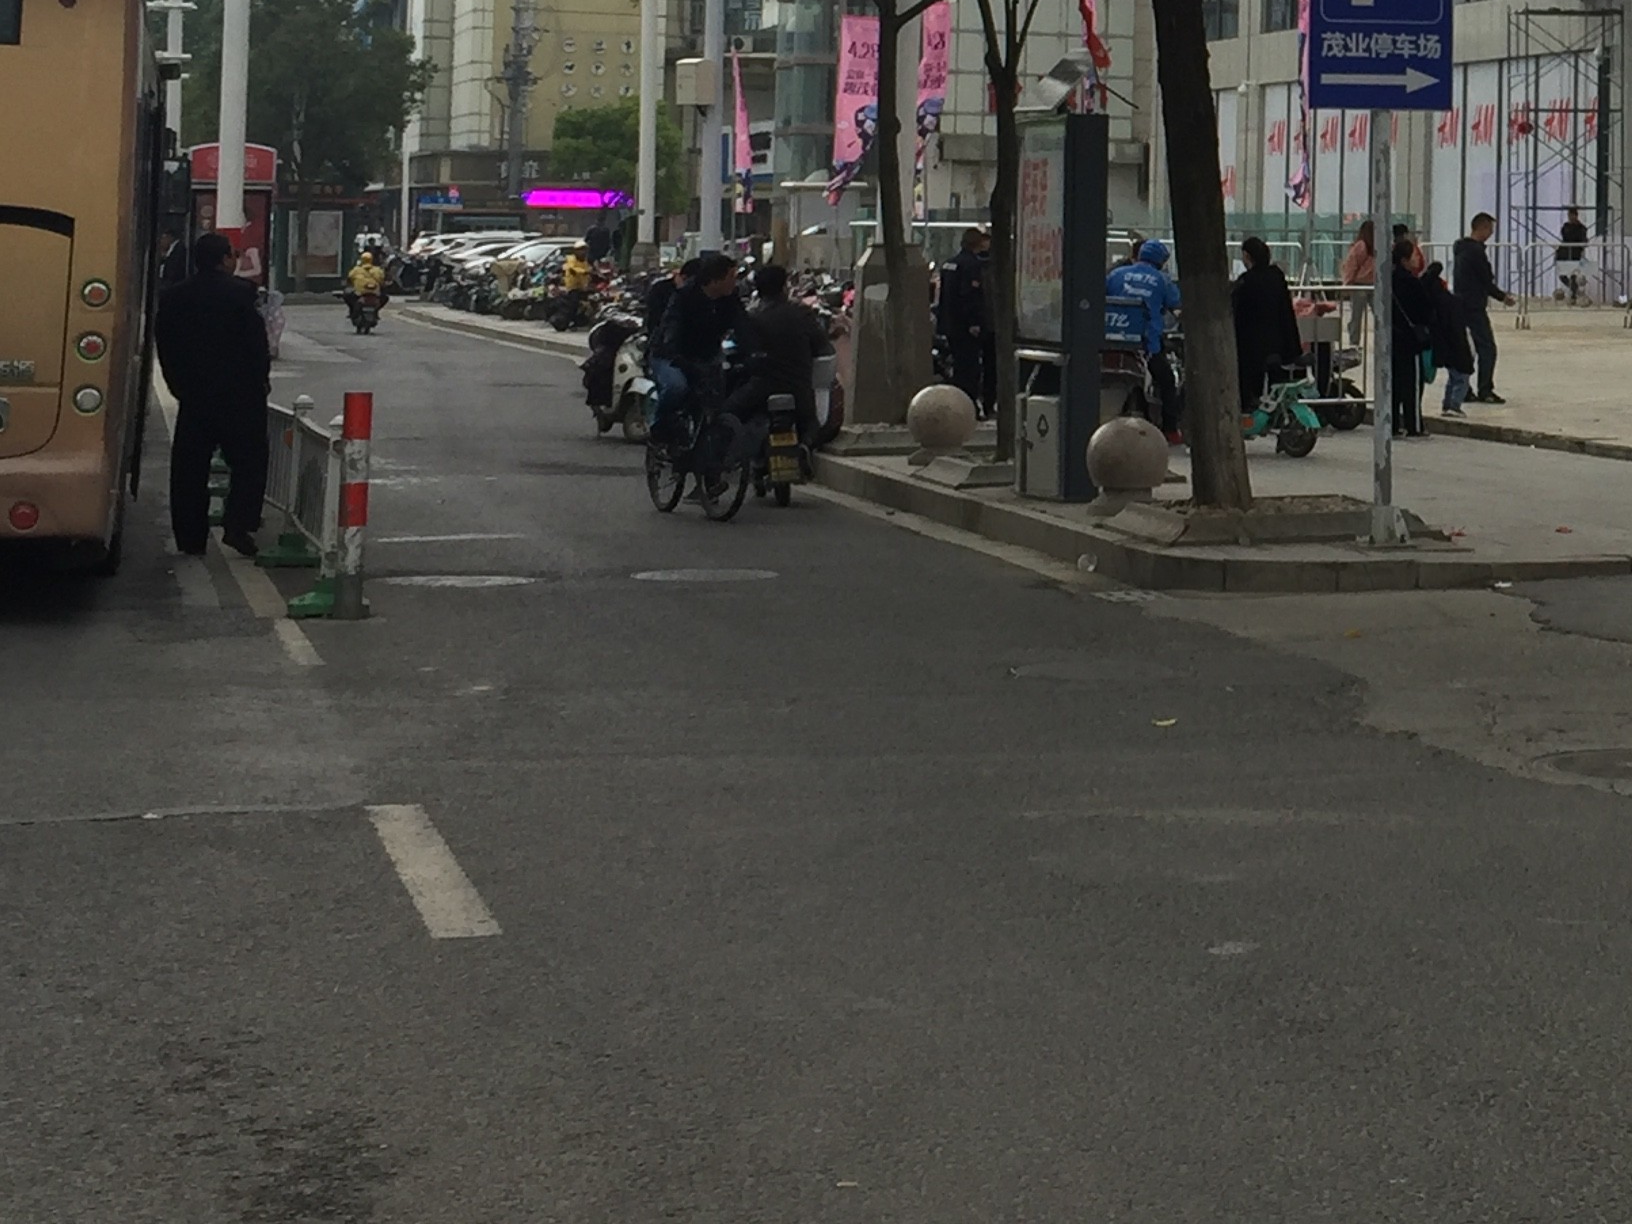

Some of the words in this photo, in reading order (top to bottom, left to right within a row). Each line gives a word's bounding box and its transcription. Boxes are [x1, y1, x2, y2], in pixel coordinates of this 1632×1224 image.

[1321, 32, 1442, 59] 茂业停车场
